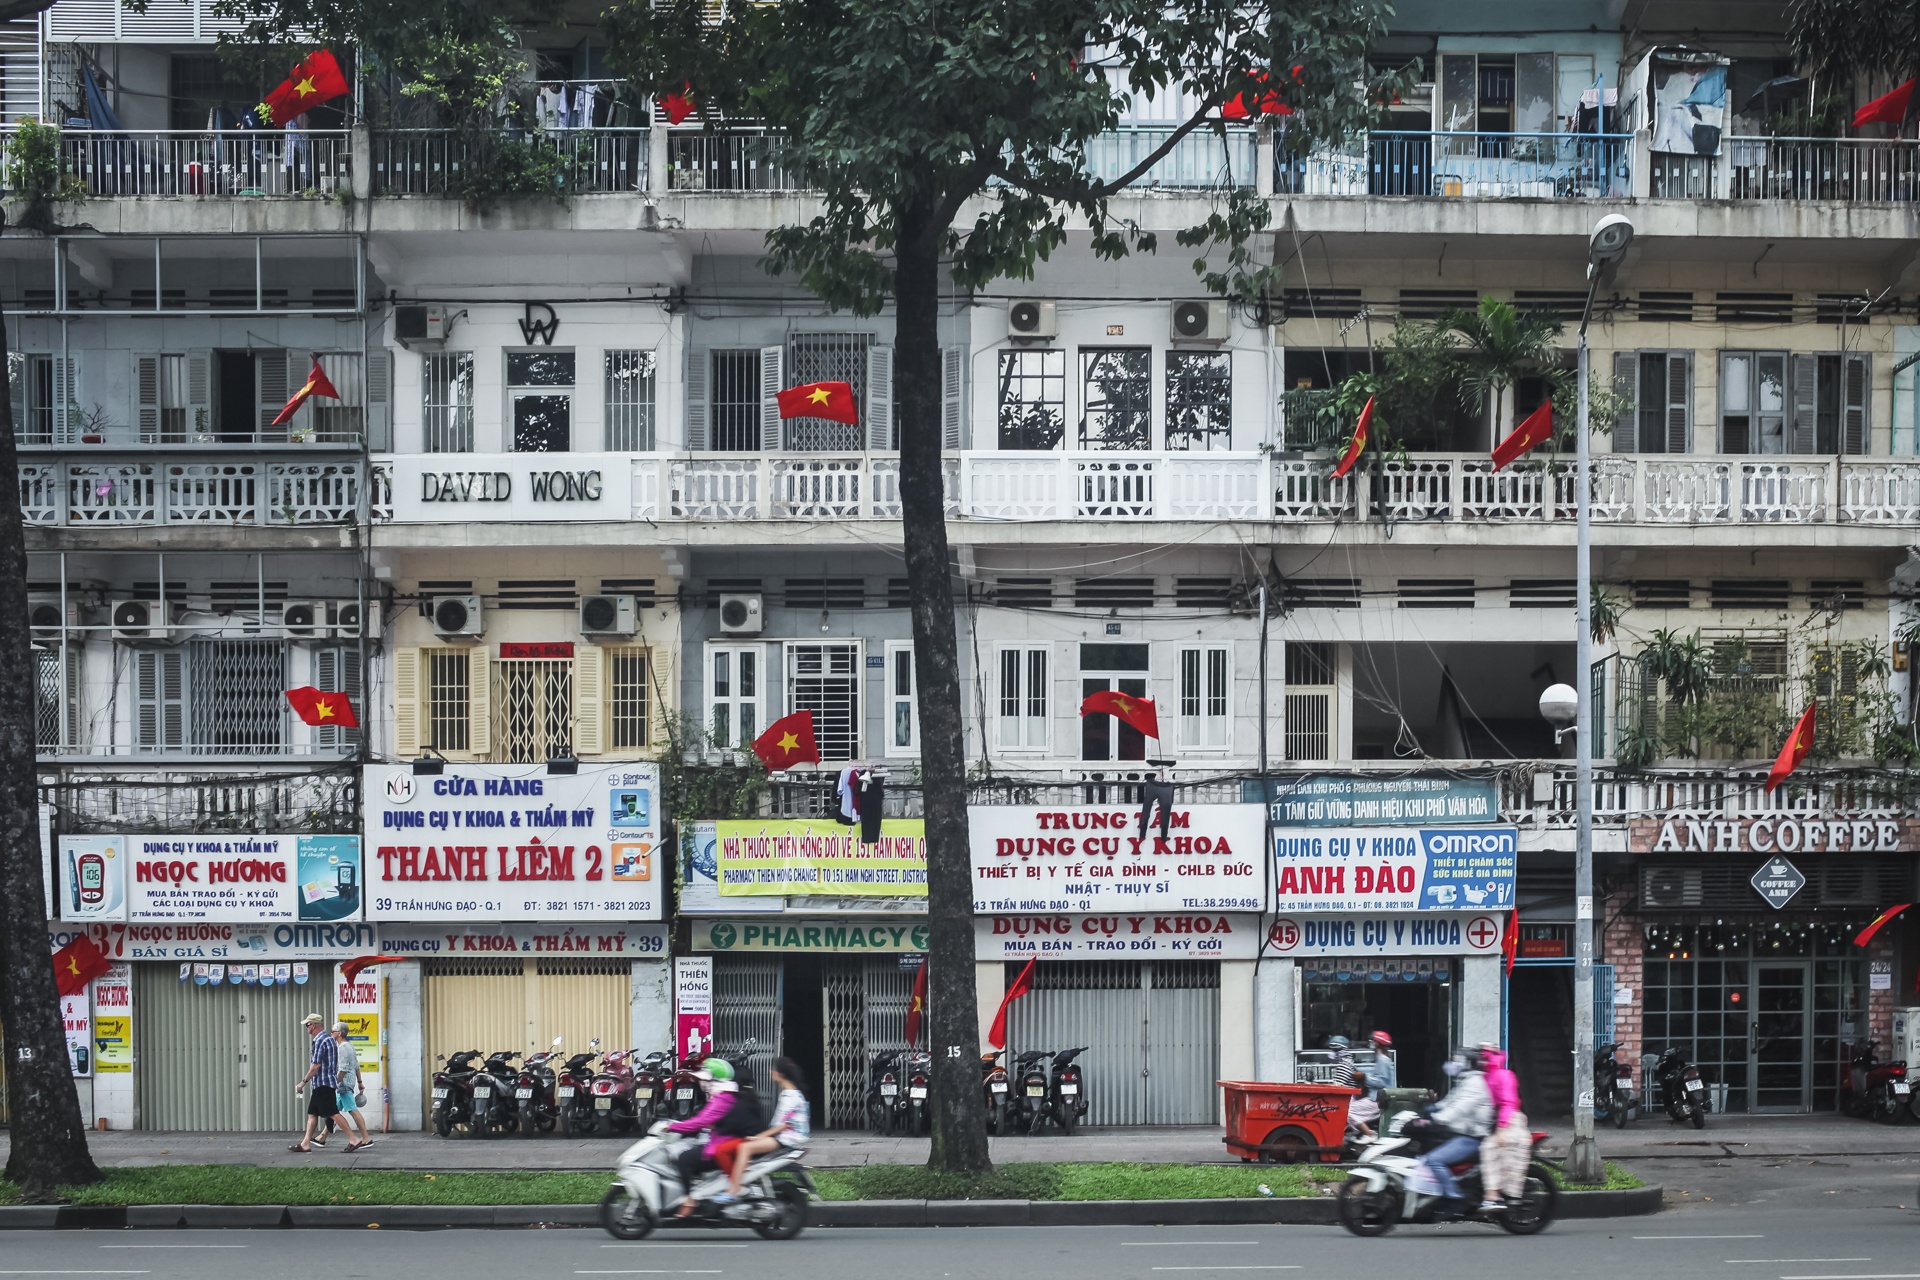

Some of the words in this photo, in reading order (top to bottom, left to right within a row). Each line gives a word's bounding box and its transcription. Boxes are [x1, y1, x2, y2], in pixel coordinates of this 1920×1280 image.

[422, 472, 511, 502] DAVID
[531, 471, 602, 501] WONG
[434, 775, 478, 796] CỬA
[484, 777, 543, 796] HÀNG
[384, 811, 425, 831] DỤNG
[429, 811, 449, 831] CỤ
[453, 811, 462, 827] Y
[466, 811, 505, 827] KHOA
[510, 812, 520, 827] &
[526, 804, 569, 827] THẨM
[572, 806, 594, 827] MỸ
[1354, 801, 1379, 819] DANH
[1405, 799, 1425, 817] KHU
[1036, 812, 1128, 830] TRUNG
[723, 832, 740, 859] NHÀ
[743, 828, 770, 859] THUỐC
[856, 837, 870, 858] 151
[1653, 820, 1742, 853] ANH
[1748, 820, 1901, 853] COFFEE
[144, 842, 170, 855] DỤNG
[172, 843, 185, 855] CỤ
[187, 843, 194, 853] Y
[196, 843, 222, 853] KHOA
[224, 843, 231, 853] &
[233, 837, 260, 853] THẨM
[264, 840, 279, 853] MỸ
[996, 837, 1075, 861] DỤNG
[1082, 837, 1120, 860] CỤ
[1130, 838, 1146, 855] Y
[1153, 836, 1232, 855] KHOA
[1277, 838, 1322, 861] DỤNG
[1328, 838, 1350, 861] CỤ
[1356, 838, 1366, 857] Y
[1372, 837, 1416, 857] KHOA
[377, 846, 488, 881] THANH
[498, 836, 574, 881] LIÊM
[586, 846, 603, 881] 2
[136, 861, 198, 888] NGỌC
[209, 858, 286, 884] HƯƠNG
[724, 870, 756, 883] PHARMACY
[758, 869, 775, 883] THIEN
[776, 869, 792, 883] HONG
[794, 868, 817, 883] CHANGE
[823, 869, 831, 882] TO
[833, 869, 843, 882] 151
[846, 869, 858, 882] HAM
[861, 869, 874, 882] NGHI
[876, 869, 901, 885] STREET,
[978, 862, 1018, 879] THIẾT
[1026, 868, 1041, 880] BỊ
[1048, 867, 1057, 877] Y
[1065, 862, 1085, 877] TẾ
[1090, 867, 1114, 877] GIA
[1122, 861, 1156, 877] ĐÌNH
[1177, 865, 1215, 876] CHLB
[1223, 861, 1253, 876] ĐỨC
[1278, 866, 1344, 894] ANH
[1354, 860, 1416, 894] ĐÀO
[170, 889, 189, 898] BÁN
[220, 888, 235, 898] ĐỔI
[247, 889, 260, 898] KÝ
[1065, 881, 1101, 897] NHẬT
[1115, 883, 1151, 897] THỤY
[1156, 879, 1169, 894] SĨ
[1760, 880, 1796, 888] COFFEE
[1768, 889, 1788, 897] ANH
[153, 899, 170, 907] CÁC
[376, 898, 392, 911] 39
[456, 901, 477, 912] ĐẠO
[485, 901, 501, 911] Q.1
[524, 901, 541, 911] ĐT:
[547, 901, 568, 910] 3821
[573, 901, 595, 910] 1571
[604, 901, 625, 910] 3821
[628, 901, 651, 910] 2023
[1020, 900, 1046, 910] HƯNG
[1049, 900, 1069, 911] ĐẠO
[1079, 900, 1091, 911] Q1
[992, 917, 1072, 938] DỤNG
[1081, 917, 1119, 937] CỤ
[1127, 917, 1143, 935] Y
[1154, 917, 1232, 934] KHOA
[1273, 925, 1296, 944] 45
[1305, 920, 1355, 953] DỤNG
[1363, 920, 1387, 952] CỤ
[1394, 920, 1405, 946] Y
[1411, 920, 1461, 946] KHOA
[93, 923, 127, 957] 37
[129, 927, 172, 944] NGỌC
[382, 939, 419, 953] DỤNG
[422, 939, 440, 953] CỤ
[446, 935, 459, 950] Y
[463, 935, 518, 952] KHOA
[522, 941, 530, 951] &
[533, 927, 593, 952] THẨM
[598, 931, 627, 952] MỸ
[639, 935, 663, 952] 39
[743, 927, 907, 947] PHARMACY
[1004, 940, 1036, 951] MUA
[1042, 939, 1072, 951] BÁN
[1087, 940, 1125, 951] TRAO
[1131, 936, 1156, 951] ĐỔI
[1172, 937, 1193, 951] KÝ
[132, 946, 167, 957] BÁN
[174, 946, 205, 957] GIÁ
[680, 969, 708, 978] THIÊN
[1871, 962, 1891, 973] 24/24
[18, 1047, 32, 1060] 13
[947, 1045, 961, 1058] 15
